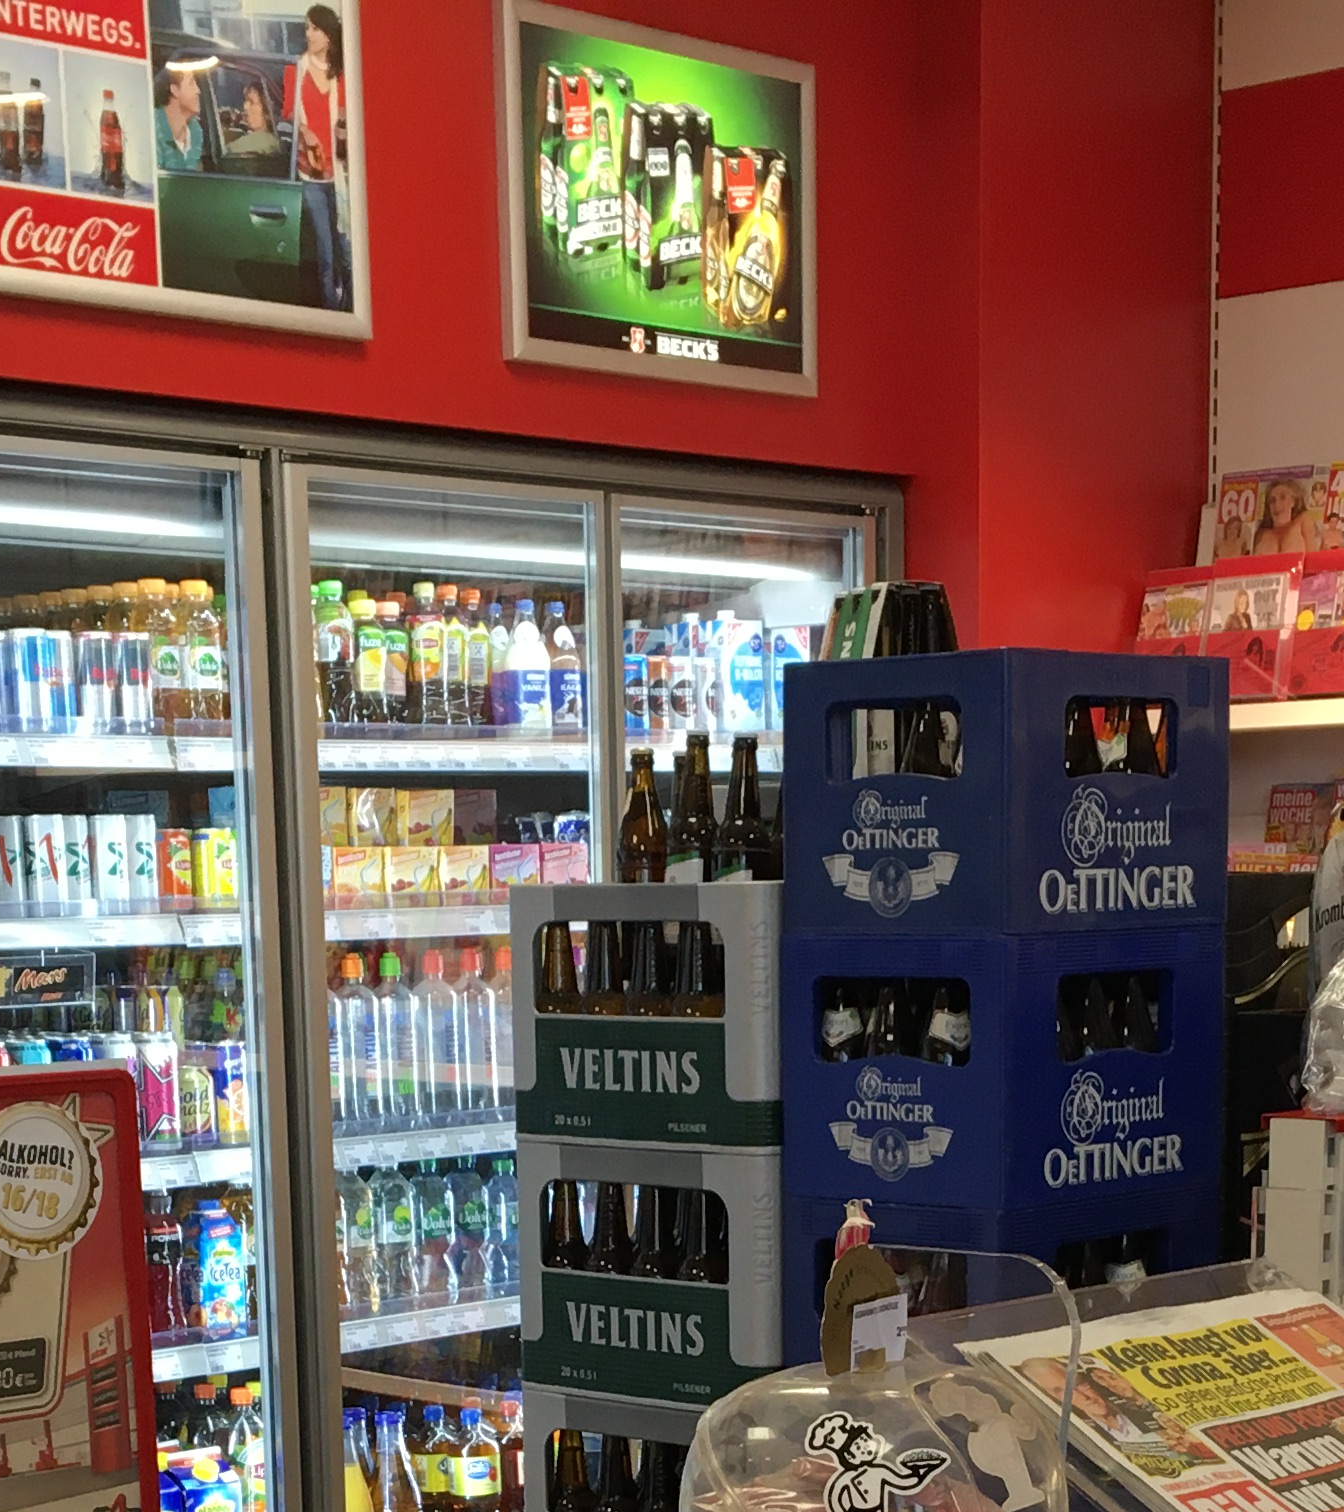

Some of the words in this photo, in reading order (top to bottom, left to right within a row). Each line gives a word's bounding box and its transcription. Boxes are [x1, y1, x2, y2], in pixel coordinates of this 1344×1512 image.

[0, 205, 141, 278] Coca-Cola
[656, 334, 719, 362] BECK'S
[1221, 491, 1255, 521] 60
[360, 636, 382, 648] fuze
[386, 640, 406, 652] fuze
[852, 788, 928, 829] Original
[1270, 807, 1314, 825] WOCHE
[1061, 784, 1172, 868] Original
[14, 967, 68, 992] Mars
[558, 1045, 702, 1096] VELTINS
[854, 1065, 922, 1102] Original
[1060, 1069, 1165, 1147] Original
[667, 1121, 707, 1134] PILSENER
[1, 1182, 60, 1220] 16/18
[566, 1299, 705, 1358] VELTINS
[1097, 1339, 1177, 1372] Keine
[1162, 1326, 1233, 1359] Angst
[672, 1380, 712, 1396] PILSENER
[1140, 1359, 1233, 1390] Corona,
